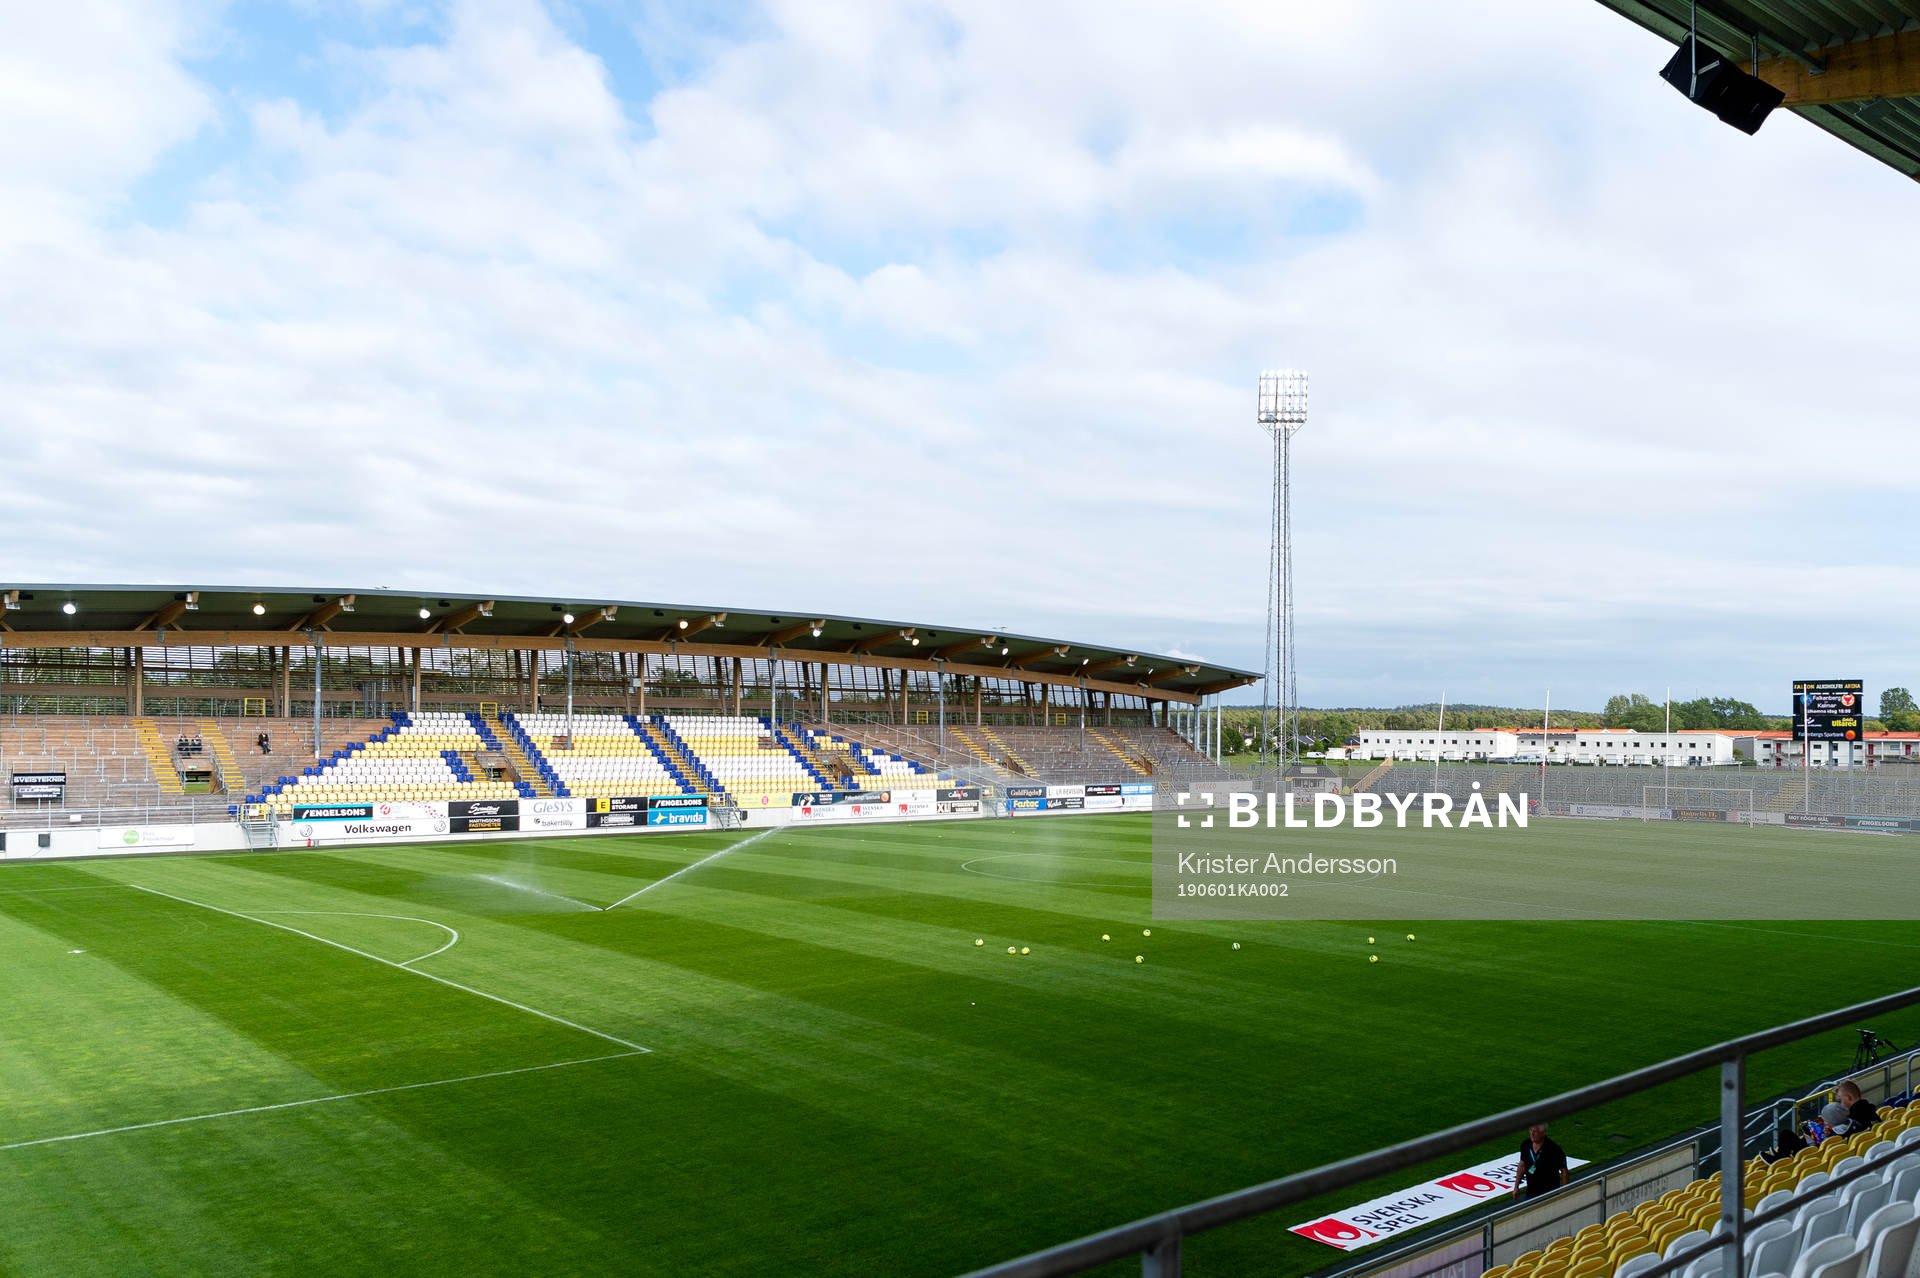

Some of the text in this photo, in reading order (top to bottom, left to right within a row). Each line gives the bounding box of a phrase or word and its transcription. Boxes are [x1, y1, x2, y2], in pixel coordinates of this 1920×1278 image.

[1831, 719, 1857, 727] Ullared
[533, 801, 573, 813] GleSYS
[660, 799, 702, 807] ENGELSONS
[309, 808, 366, 817] ENGELSONS
[669, 811, 703, 823] bravida
[344, 824, 412, 834] Volkswagen
[1861, 820, 1899, 828] ENGELSONS
[1351, 1192, 1444, 1226] SVENSKA
[1374, 1213, 1430, 1233] SPEL
